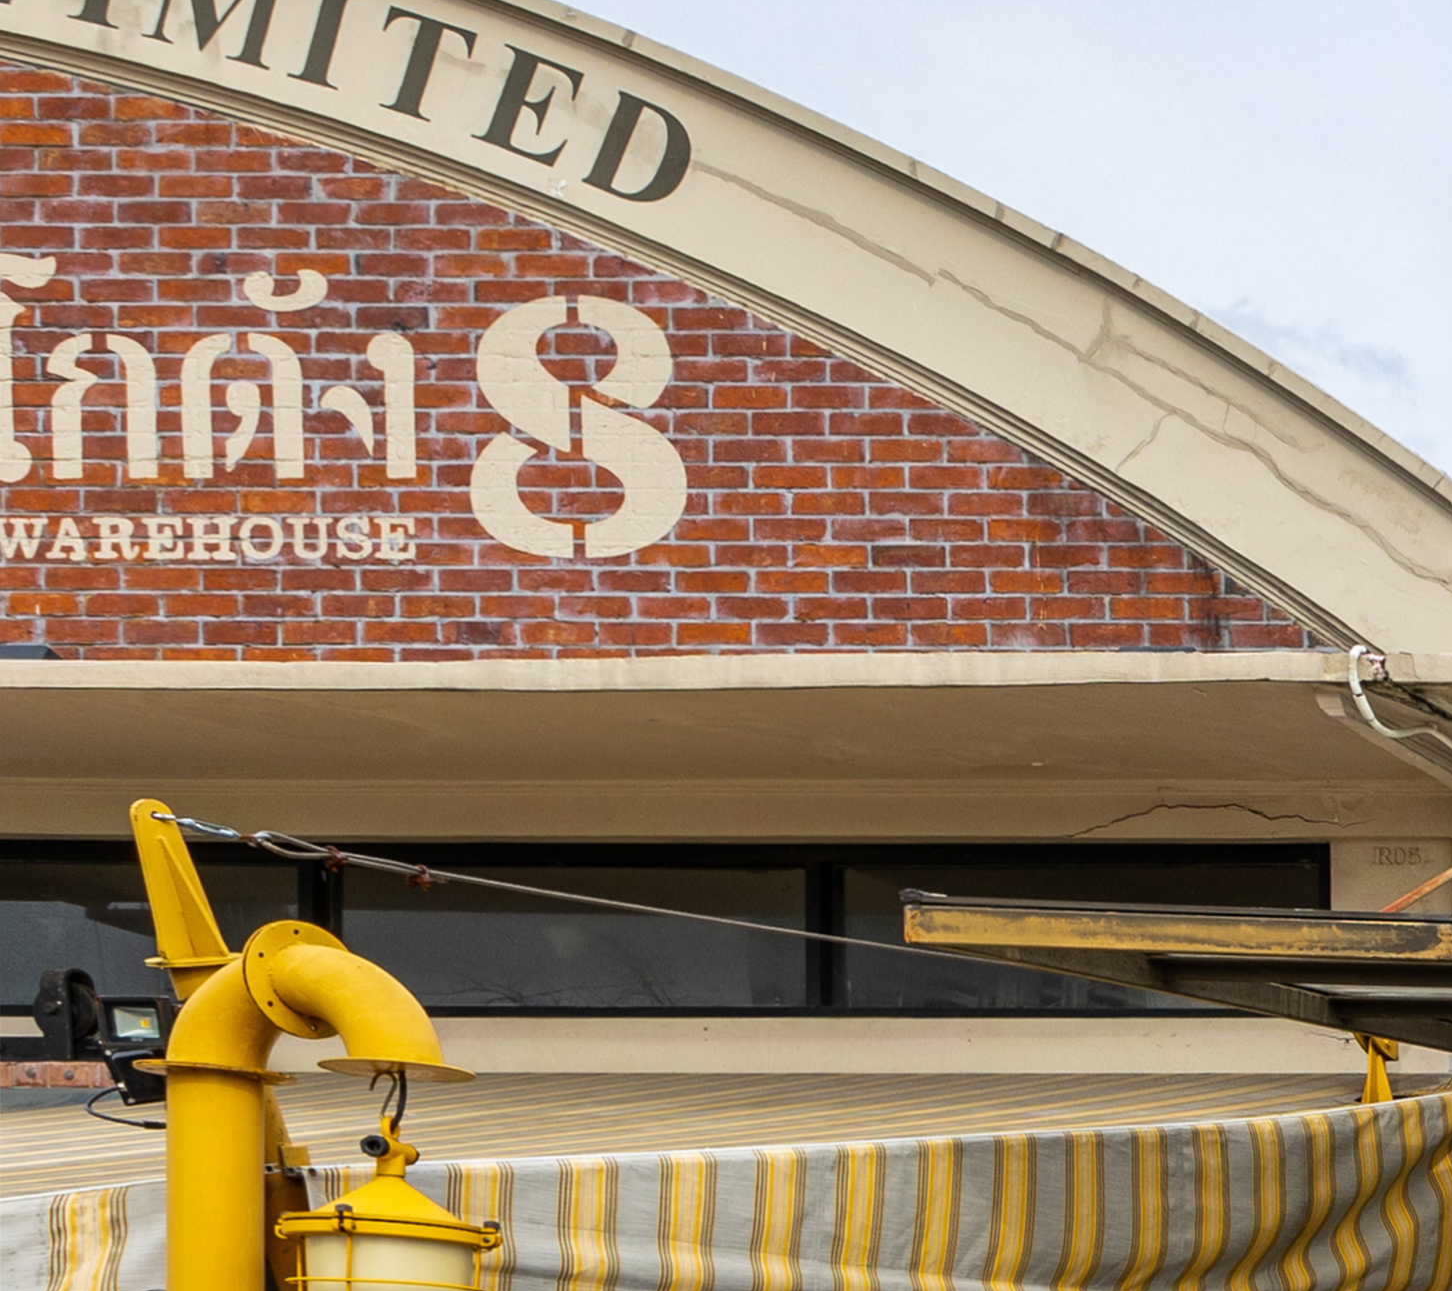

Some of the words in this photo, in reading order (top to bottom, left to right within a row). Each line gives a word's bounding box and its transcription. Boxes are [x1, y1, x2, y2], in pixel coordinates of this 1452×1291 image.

[469, 294, 688, 559] 8
[0, 515, 418, 562] WAREHOUSE
[1372, 846, 1422, 866] R05
